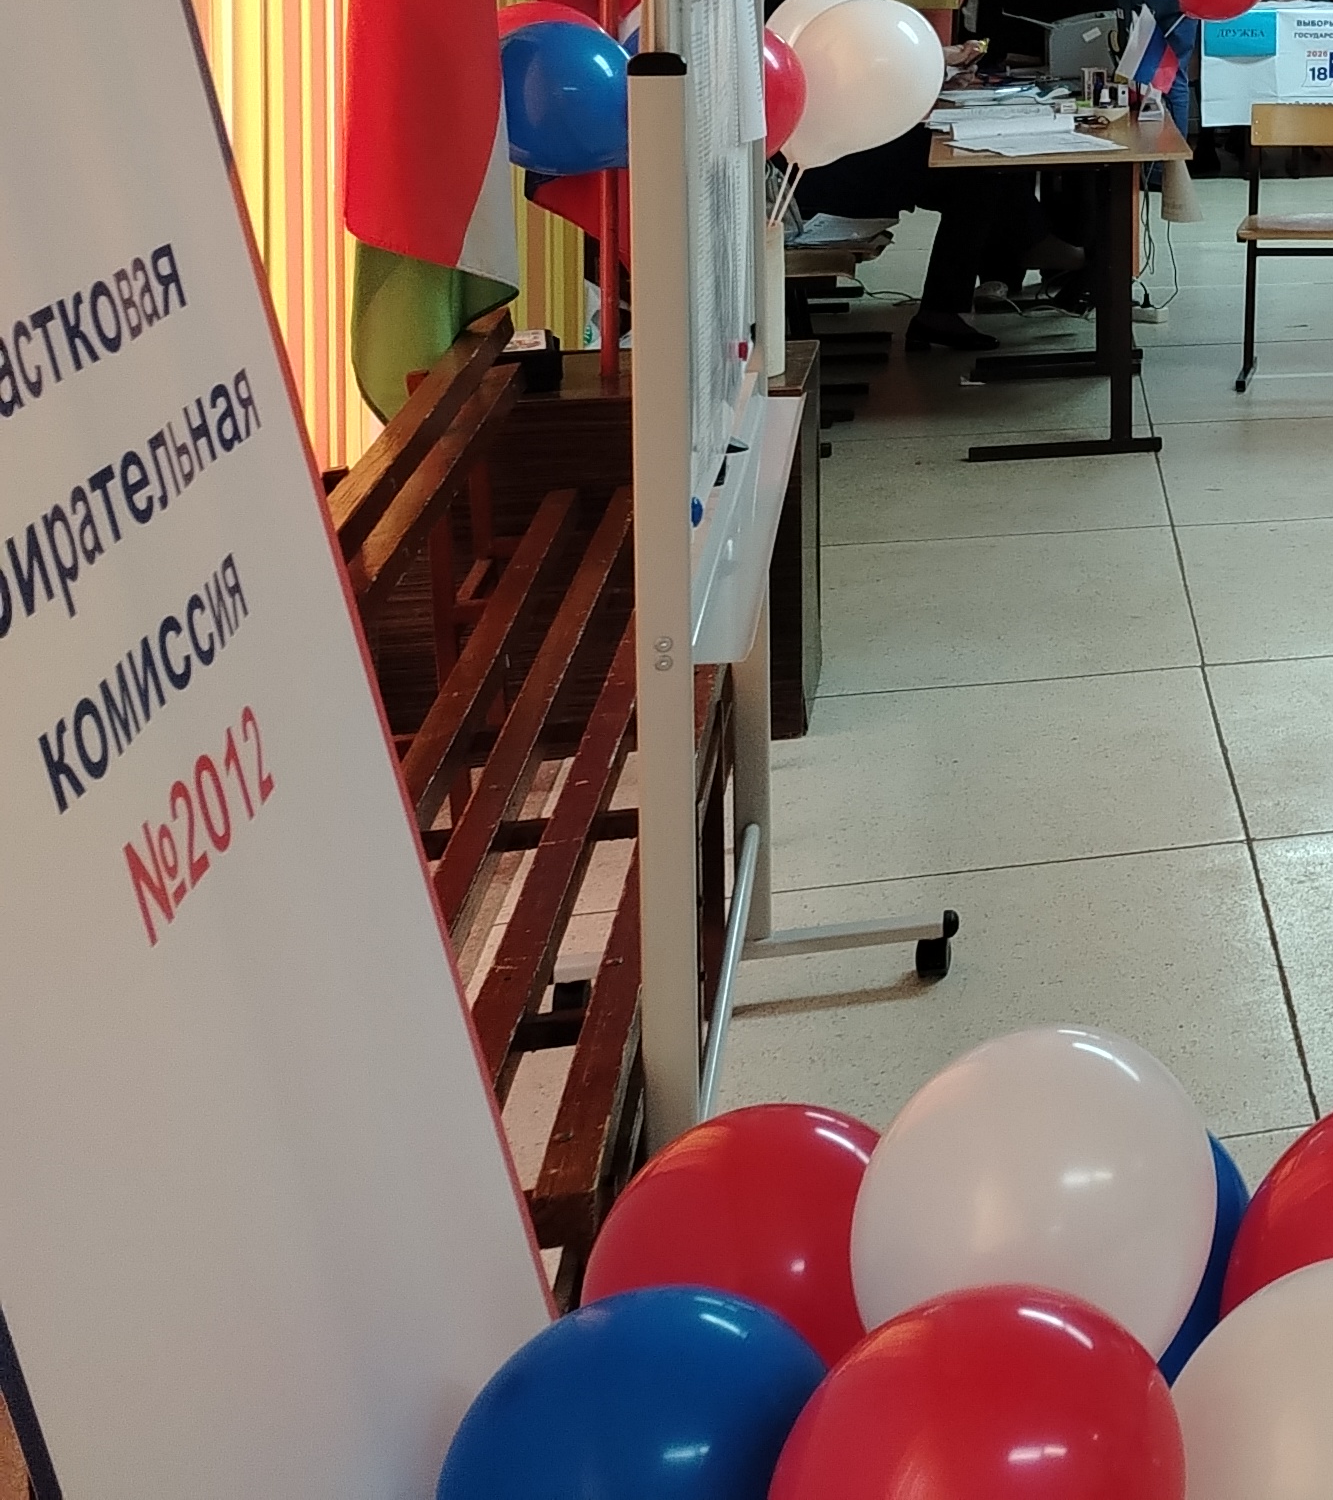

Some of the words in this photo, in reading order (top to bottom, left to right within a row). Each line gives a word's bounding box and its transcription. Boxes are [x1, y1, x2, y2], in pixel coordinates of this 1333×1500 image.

[1217, 27, 1265, 39] ДРУЖБА
[1309, 67, 1328, 81] 18
[0, 242, 187, 418] астковая
[37, 551, 250, 815] комиссия
[123, 705, 275, 948] №2012
